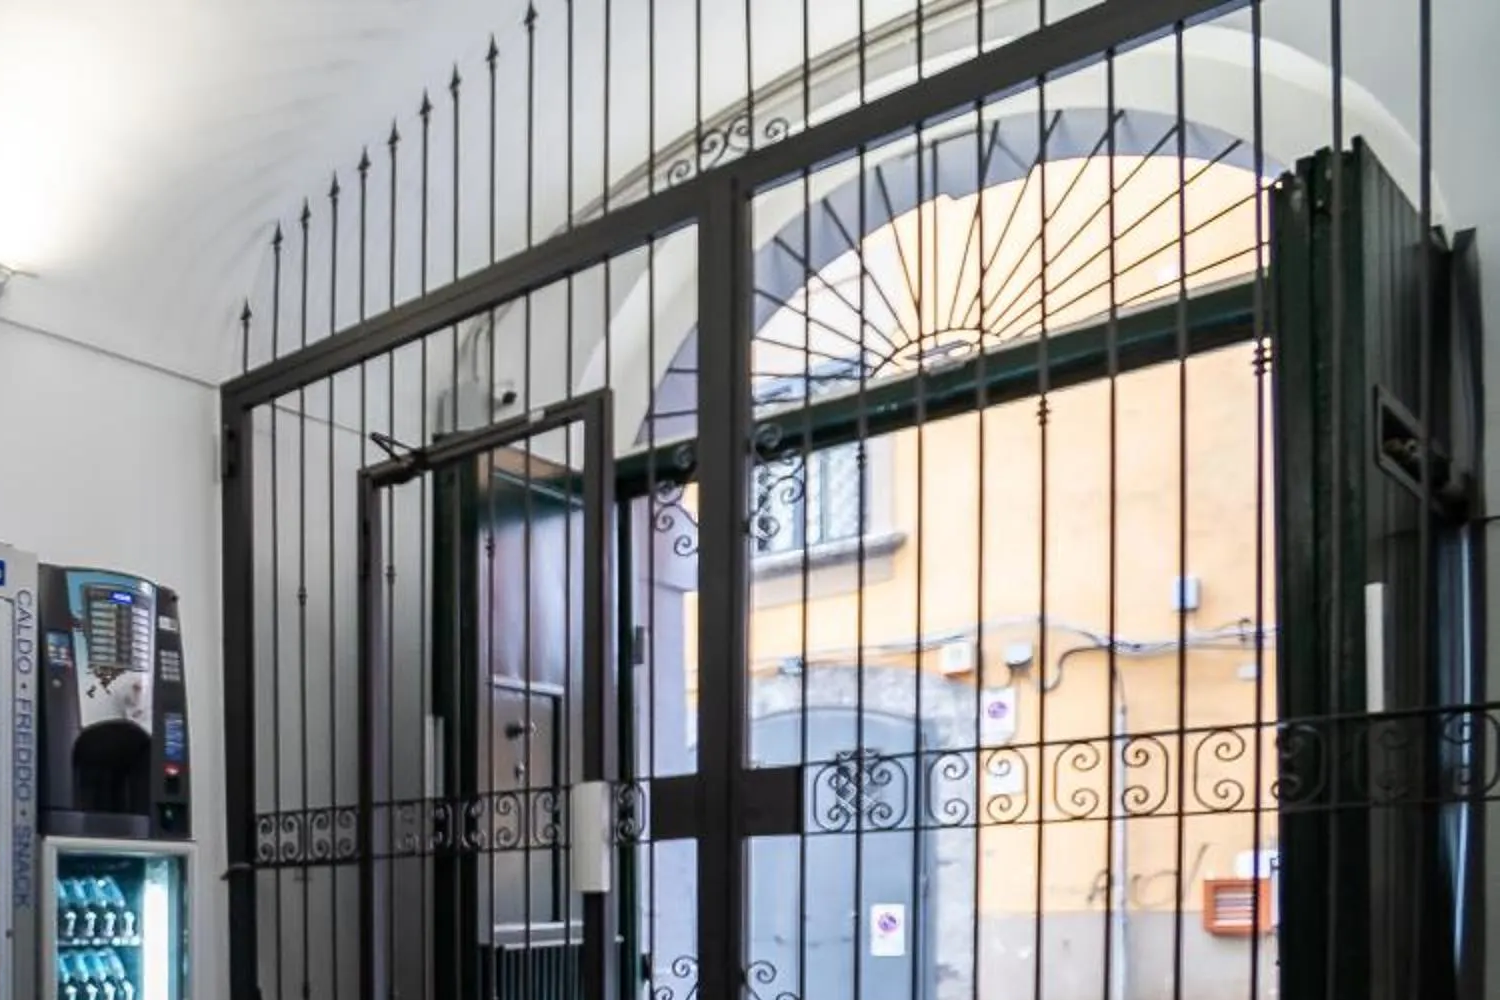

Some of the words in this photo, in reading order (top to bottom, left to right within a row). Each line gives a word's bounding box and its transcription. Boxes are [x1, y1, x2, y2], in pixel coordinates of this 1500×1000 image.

[16, 589, 32, 675] CALDO
[16, 698, 32, 801] FREDDO
[14, 824, 31, 908] SNACK
